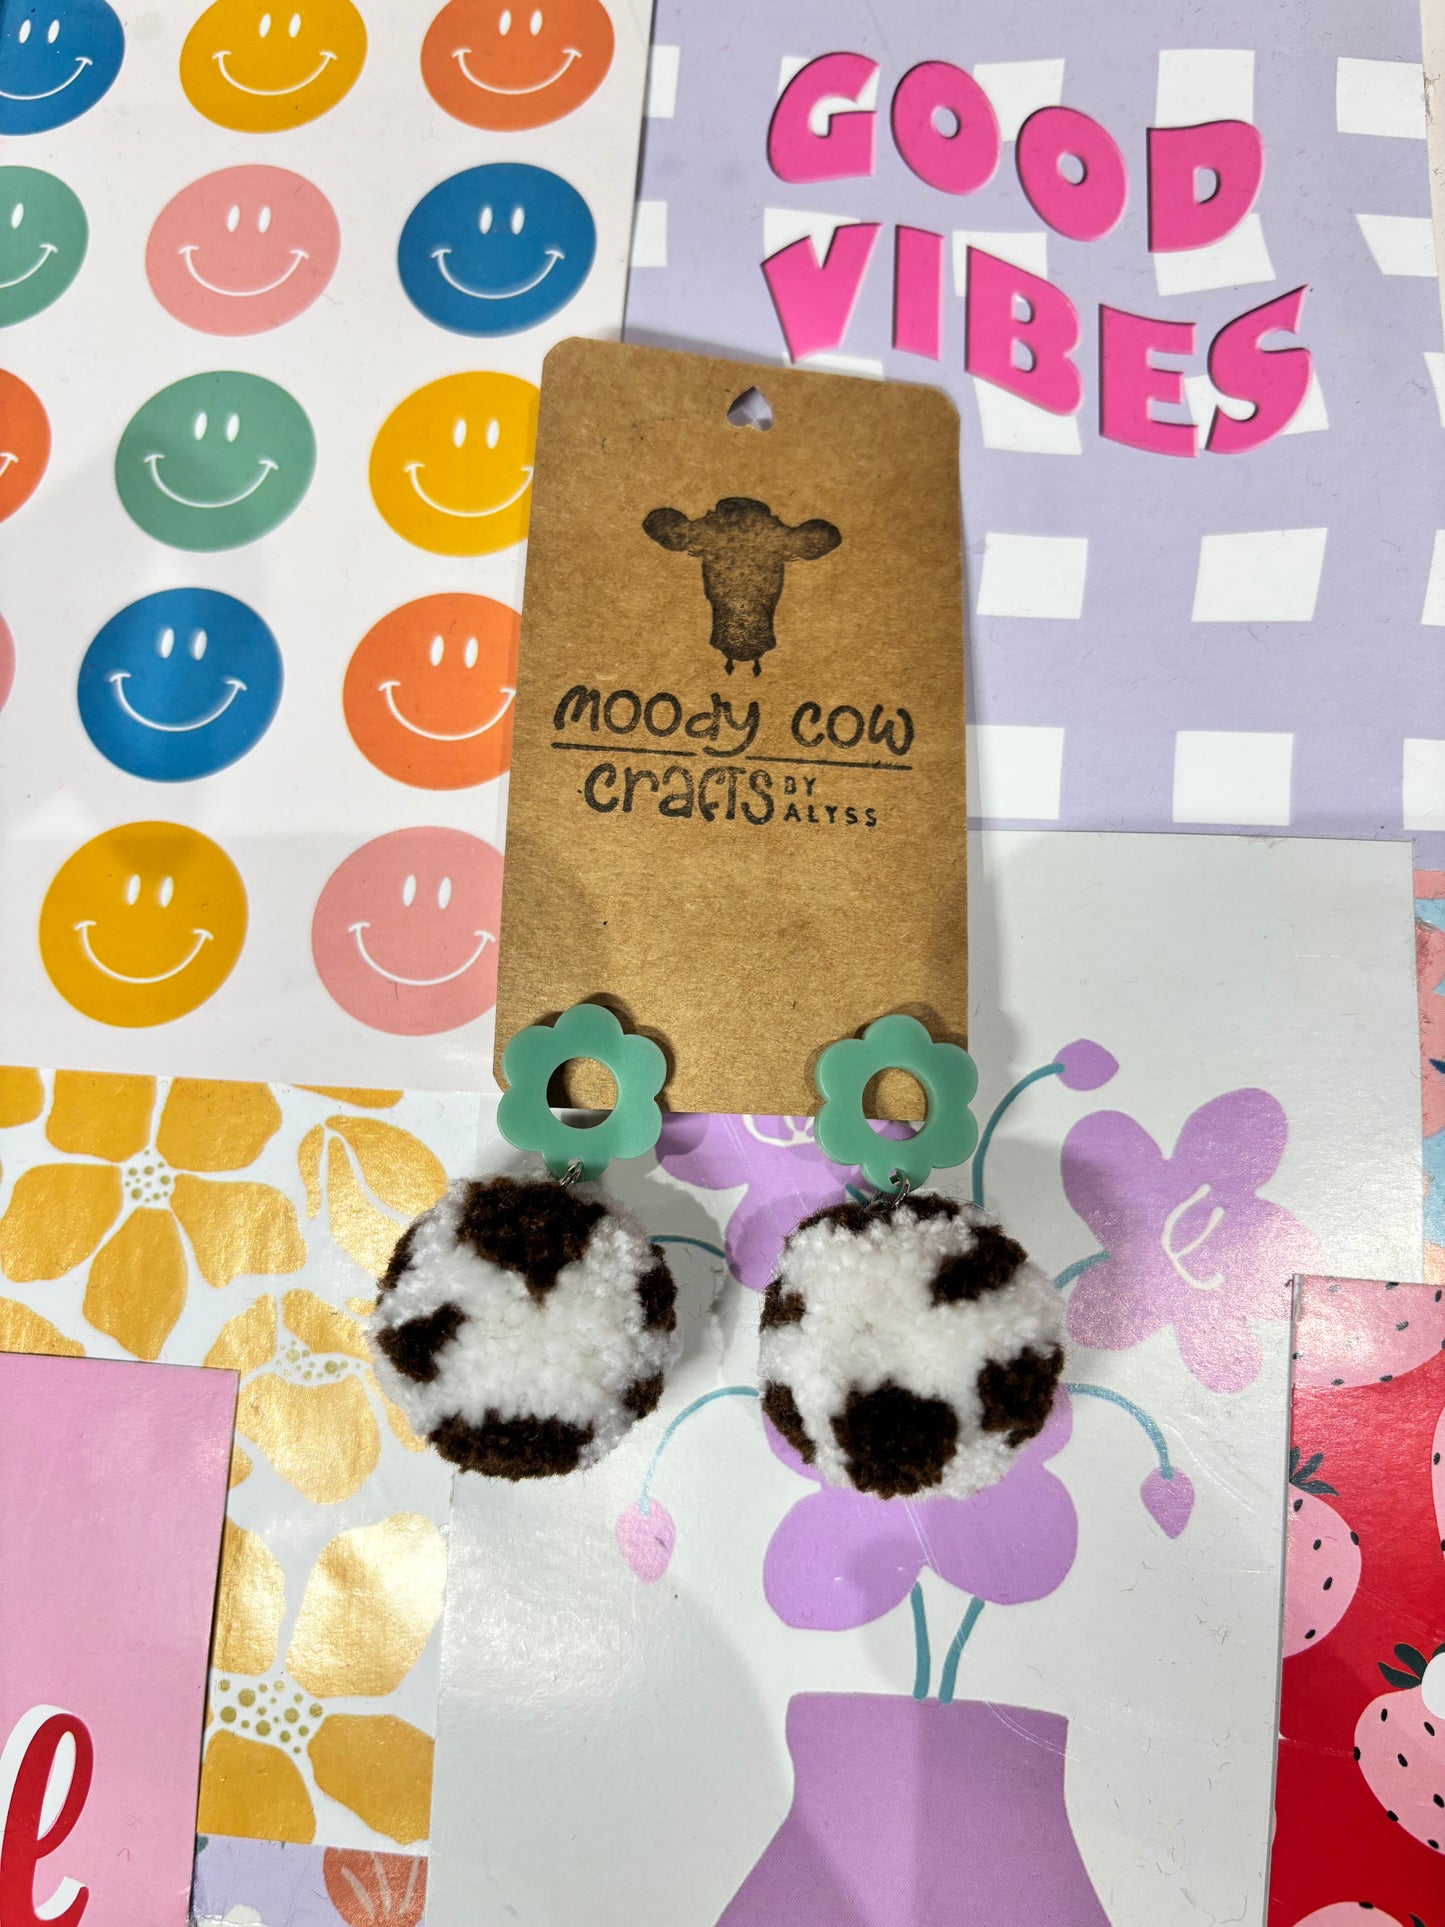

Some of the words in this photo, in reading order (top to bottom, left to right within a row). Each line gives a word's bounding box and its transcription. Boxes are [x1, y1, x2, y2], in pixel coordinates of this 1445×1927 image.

[766, 51, 1264, 253] GOOD
[760, 222, 1312, 458] VIBES
[784, 776, 817, 797] BY
[784, 804, 878, 828] ALYSS
